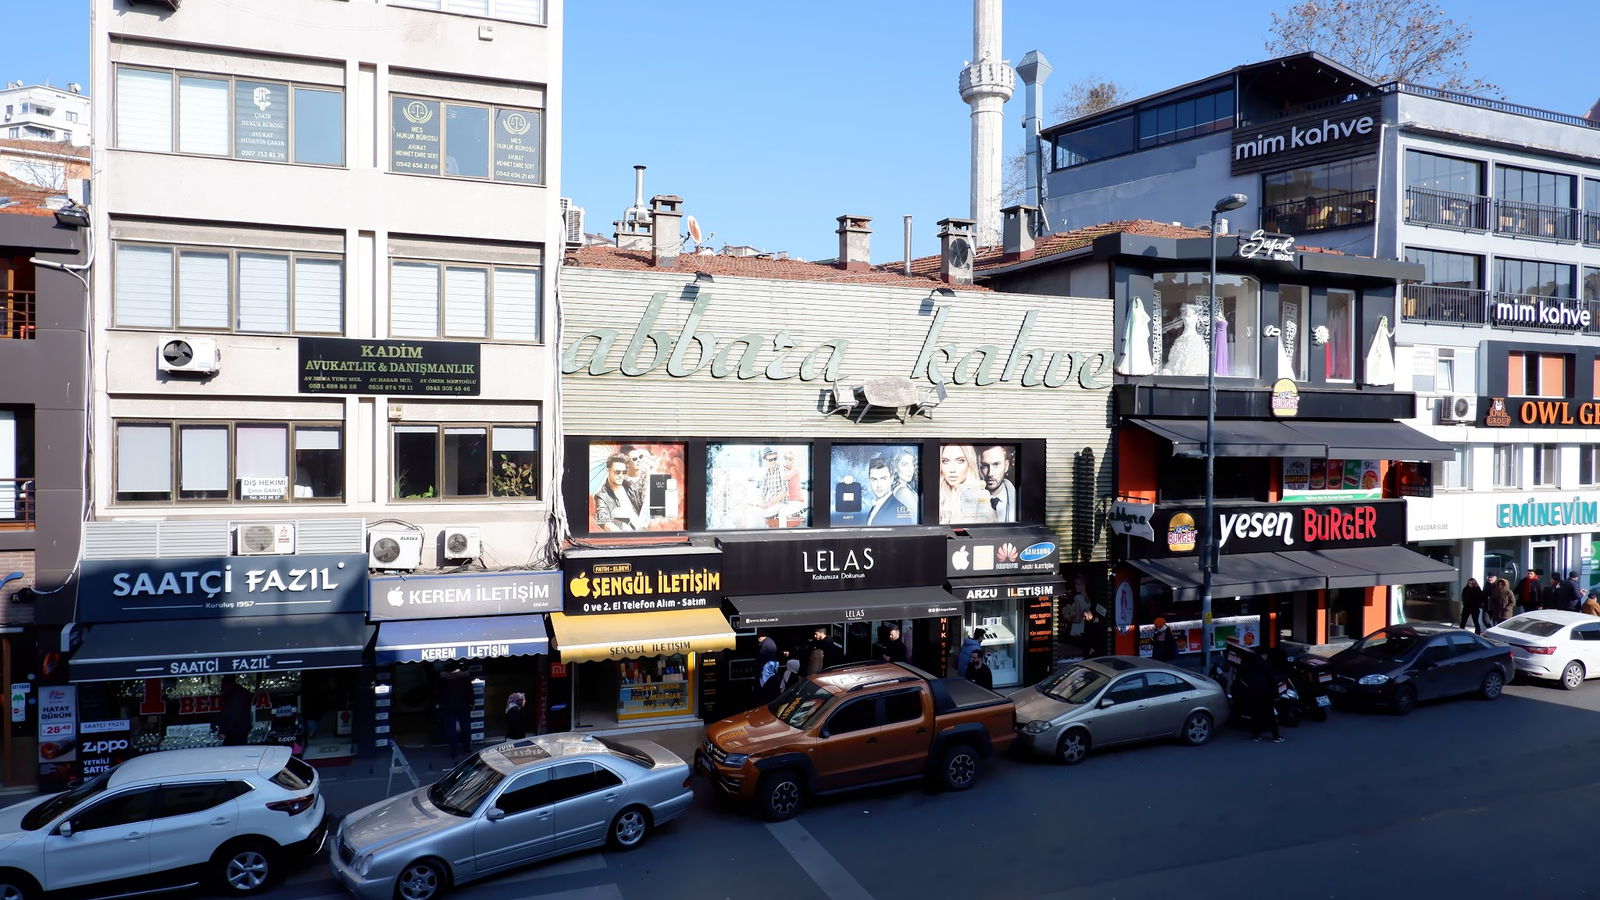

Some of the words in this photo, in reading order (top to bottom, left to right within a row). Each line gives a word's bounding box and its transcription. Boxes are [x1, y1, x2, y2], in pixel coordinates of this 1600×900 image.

[396, 132, 415, 140] HUKUK
[1236, 134, 1285, 160] mim
[1291, 116, 1374, 148] kahve
[396, 160, 412, 168] 0542
[1274, 253, 1294, 262] MODA
[1498, 298, 1535, 322] mim
[1540, 300, 1590, 326] kahve
[360, 343, 423, 358] KADİM
[911, 304, 1114, 389] kahve
[305, 360, 377, 372] AVUKATLIK
[378, 362, 388, 372] &
[390, 362, 475, 376] DANIŞMANLIK
[1522, 400, 1574, 424] OWL
[1496, 496, 1598, 528] EMİNEVİM
[1219, 511, 1294, 548] yesen
[802, 547, 875, 573] LELAS
[112, 564, 232, 598] SAATÇİ
[244, 567, 339, 593] FAZIL
[592, 571, 653, 599] ŞENGÜL
[658, 568, 720, 594] İLETİŞİM
[410, 587, 470, 604] KEREM
[476, 581, 549, 603] İLETİŞİM
[966, 588, 998, 600] ARZU
[612, 602, 621, 610] El
[622, 600, 655, 610] Telefon
[656, 599, 676, 608] Alım
[682, 598, 706, 606] Satım
[845, 609, 865, 618] LELAS
[421, 648, 456, 660] KEREM
[170, 658, 219, 674] SAATÇİ
[232, 657, 270, 670] FAZIL
[41, 712, 72, 720] DÜRÜM
[82, 739, 129, 754] zippo
